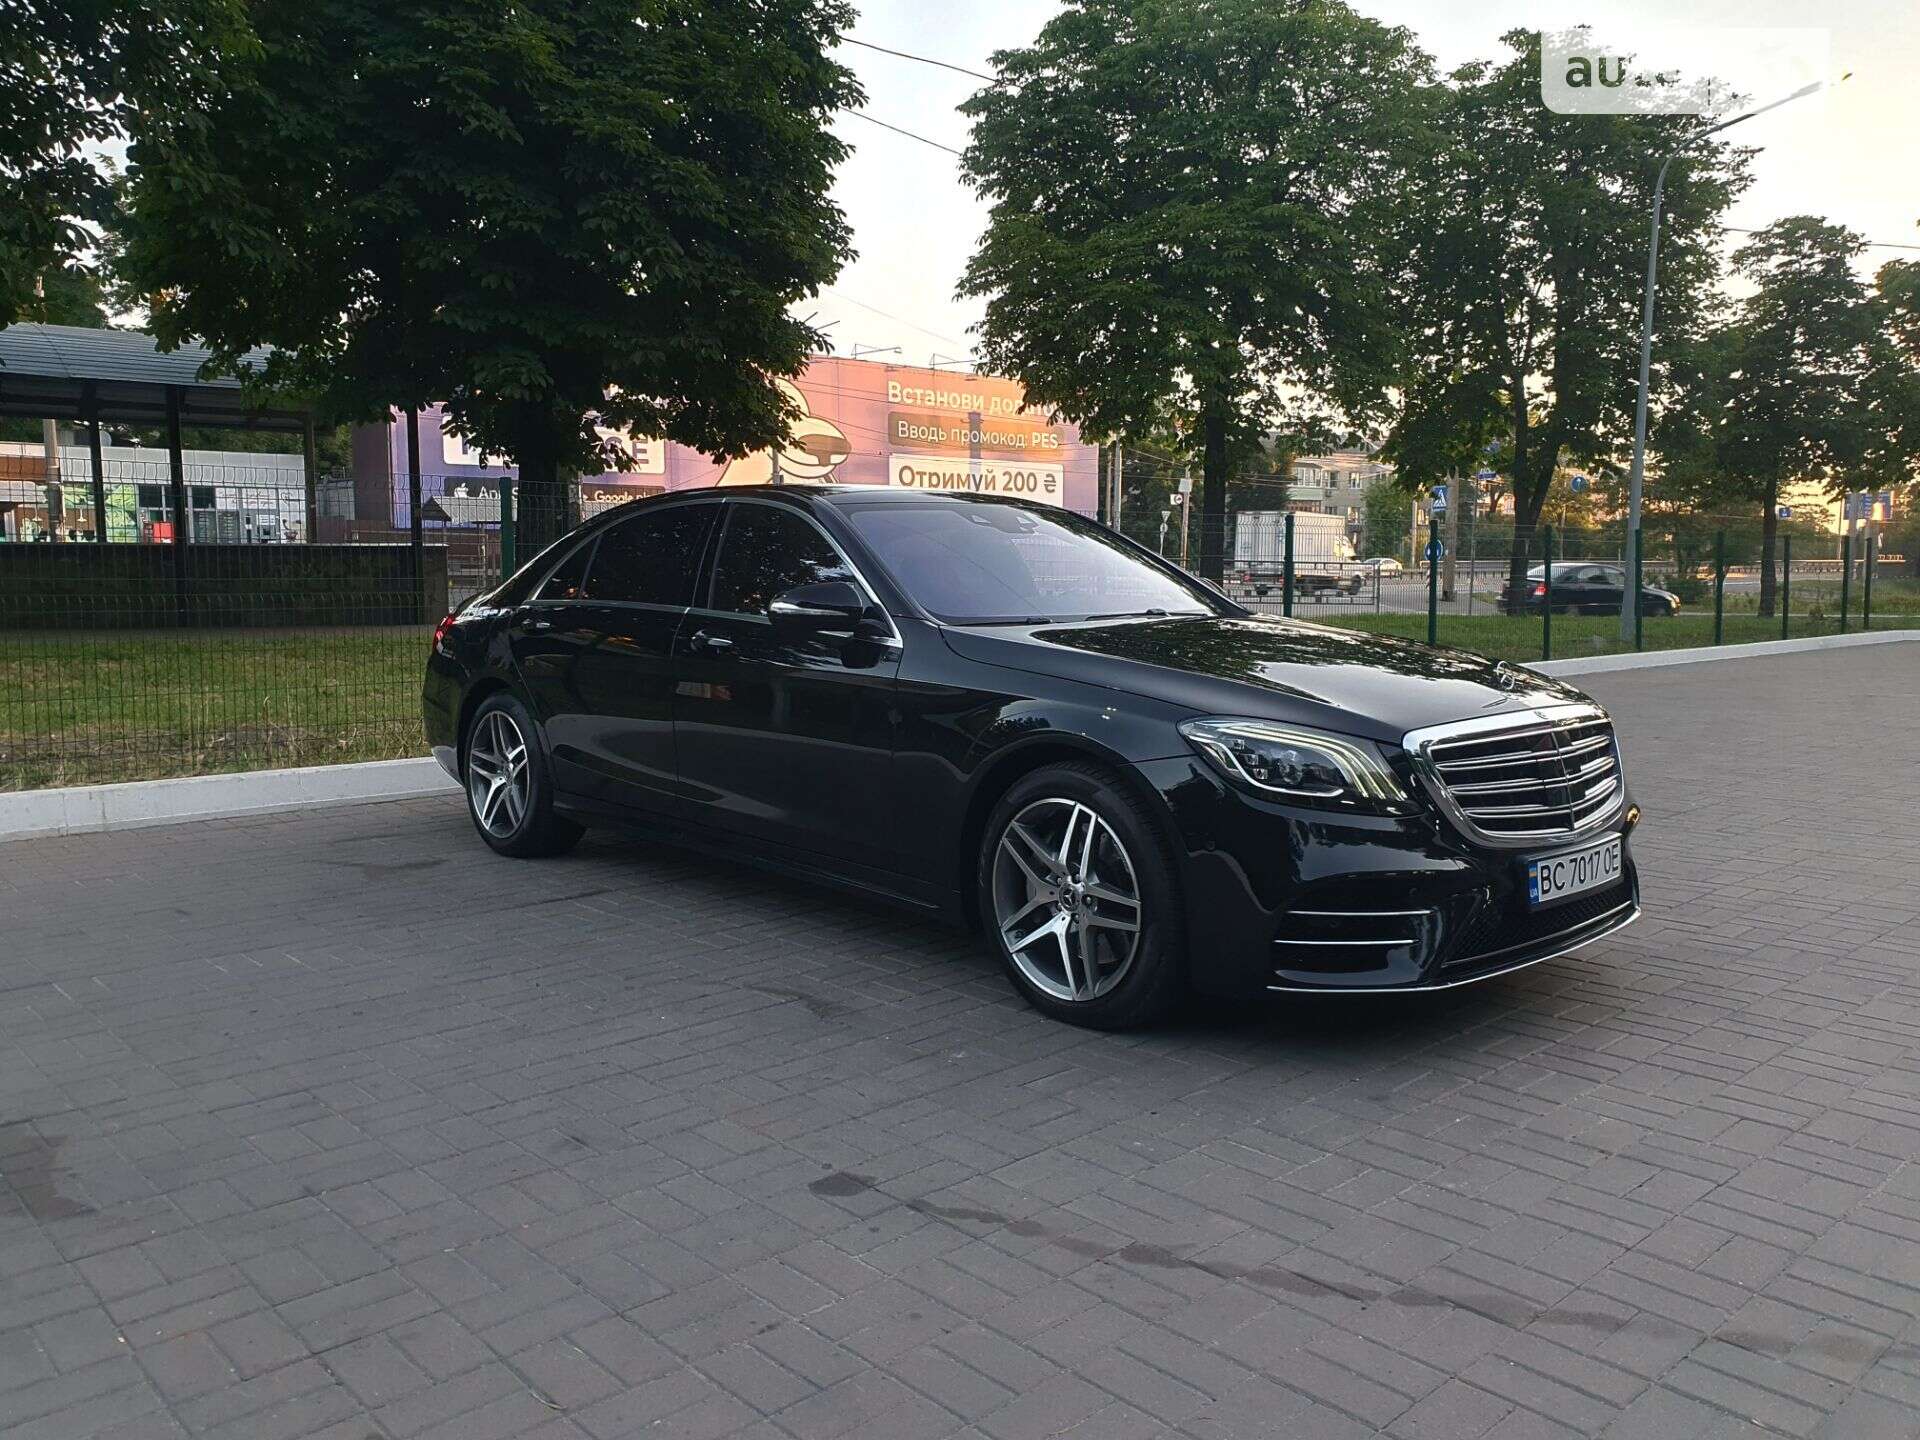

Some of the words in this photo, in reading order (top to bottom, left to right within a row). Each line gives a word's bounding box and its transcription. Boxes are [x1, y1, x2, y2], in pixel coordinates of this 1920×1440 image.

[888, 381, 984, 411] Встанови
[898, 420, 948, 442] Вводь
[951, 428, 1028, 449] промокод:
[1032, 432, 1059, 449] PES
[899, 465, 996, 492] Отримуй
[1002, 471, 1037, 492] 200
[594, 490, 633, 502] Google
[1540, 861, 1566, 895] BC
[1569, 849, 1601, 888] 7017
